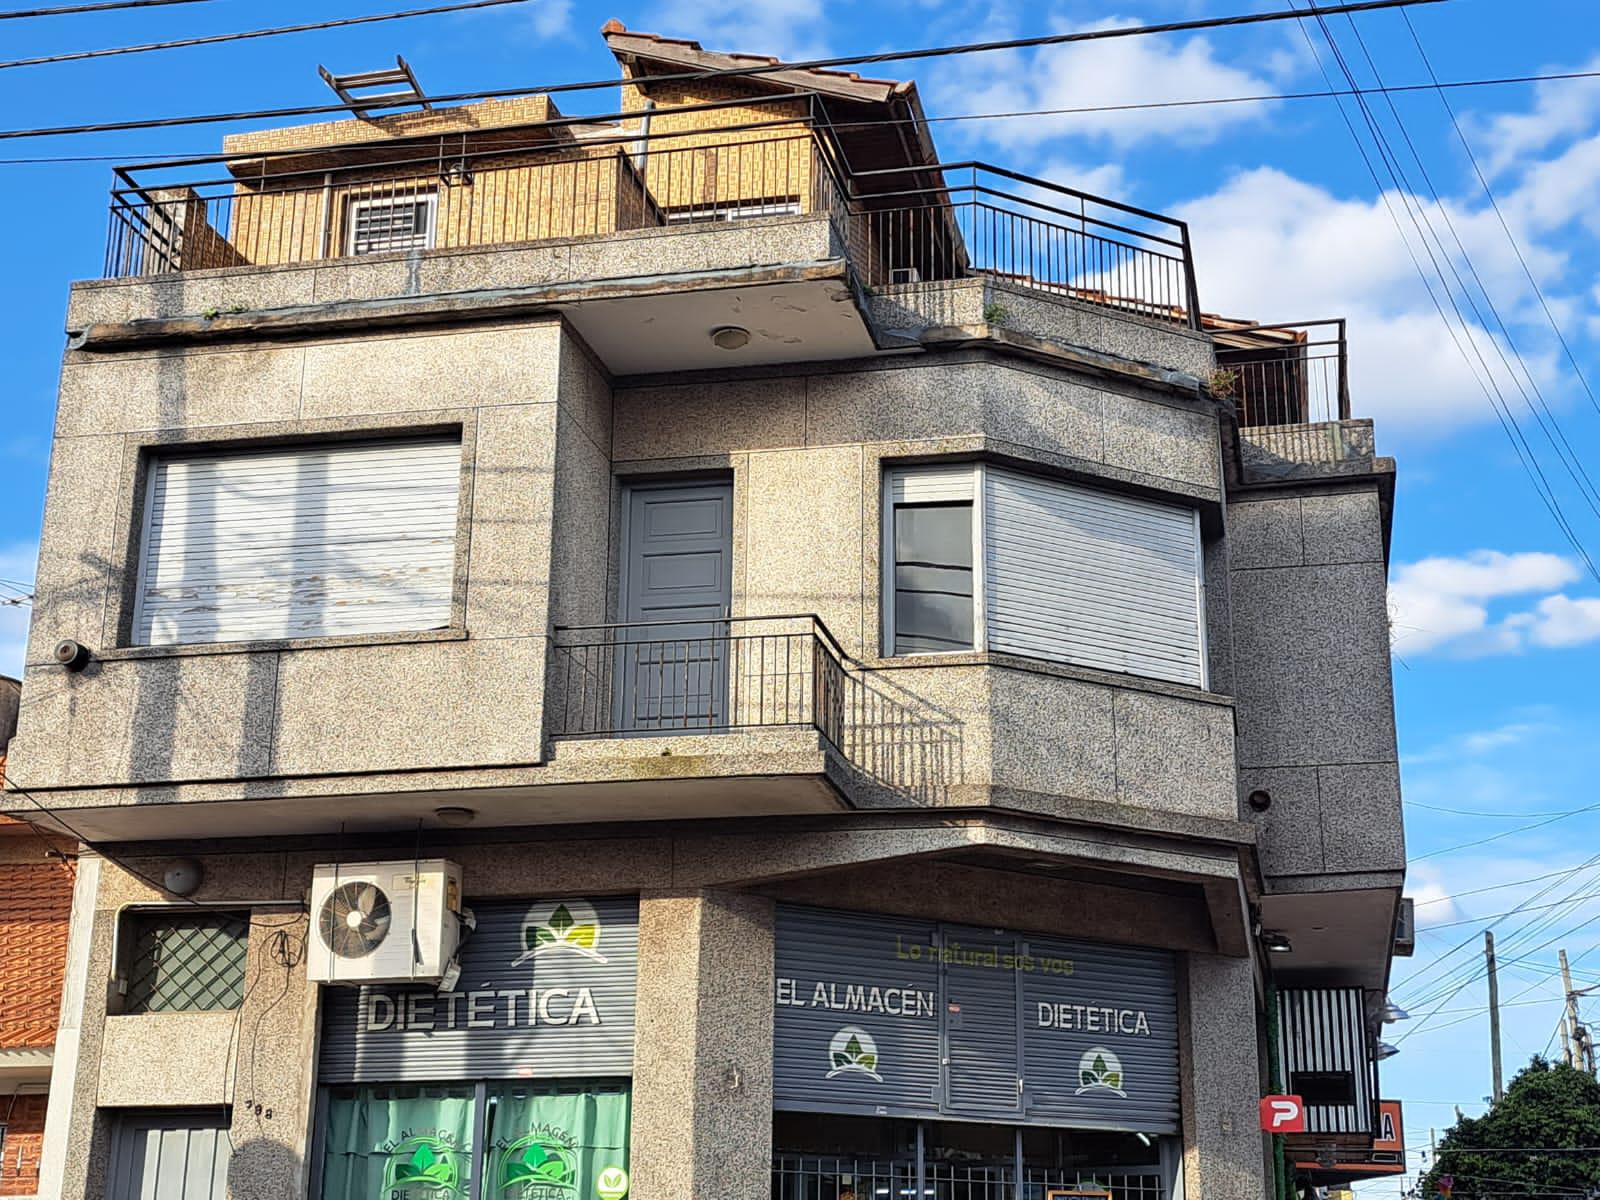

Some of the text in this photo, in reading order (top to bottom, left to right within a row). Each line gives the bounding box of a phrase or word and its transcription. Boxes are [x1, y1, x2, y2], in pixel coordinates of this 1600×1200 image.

[896, 935, 1074, 976] Lo natural sos vos
[366, 982, 602, 1031] DIETÉTICA
[776, 978, 935, 1017] EL ALMACÉN
[1037, 1000, 1151, 1036] DIETÉTICA
[383, 1140, 400, 1153] EL
